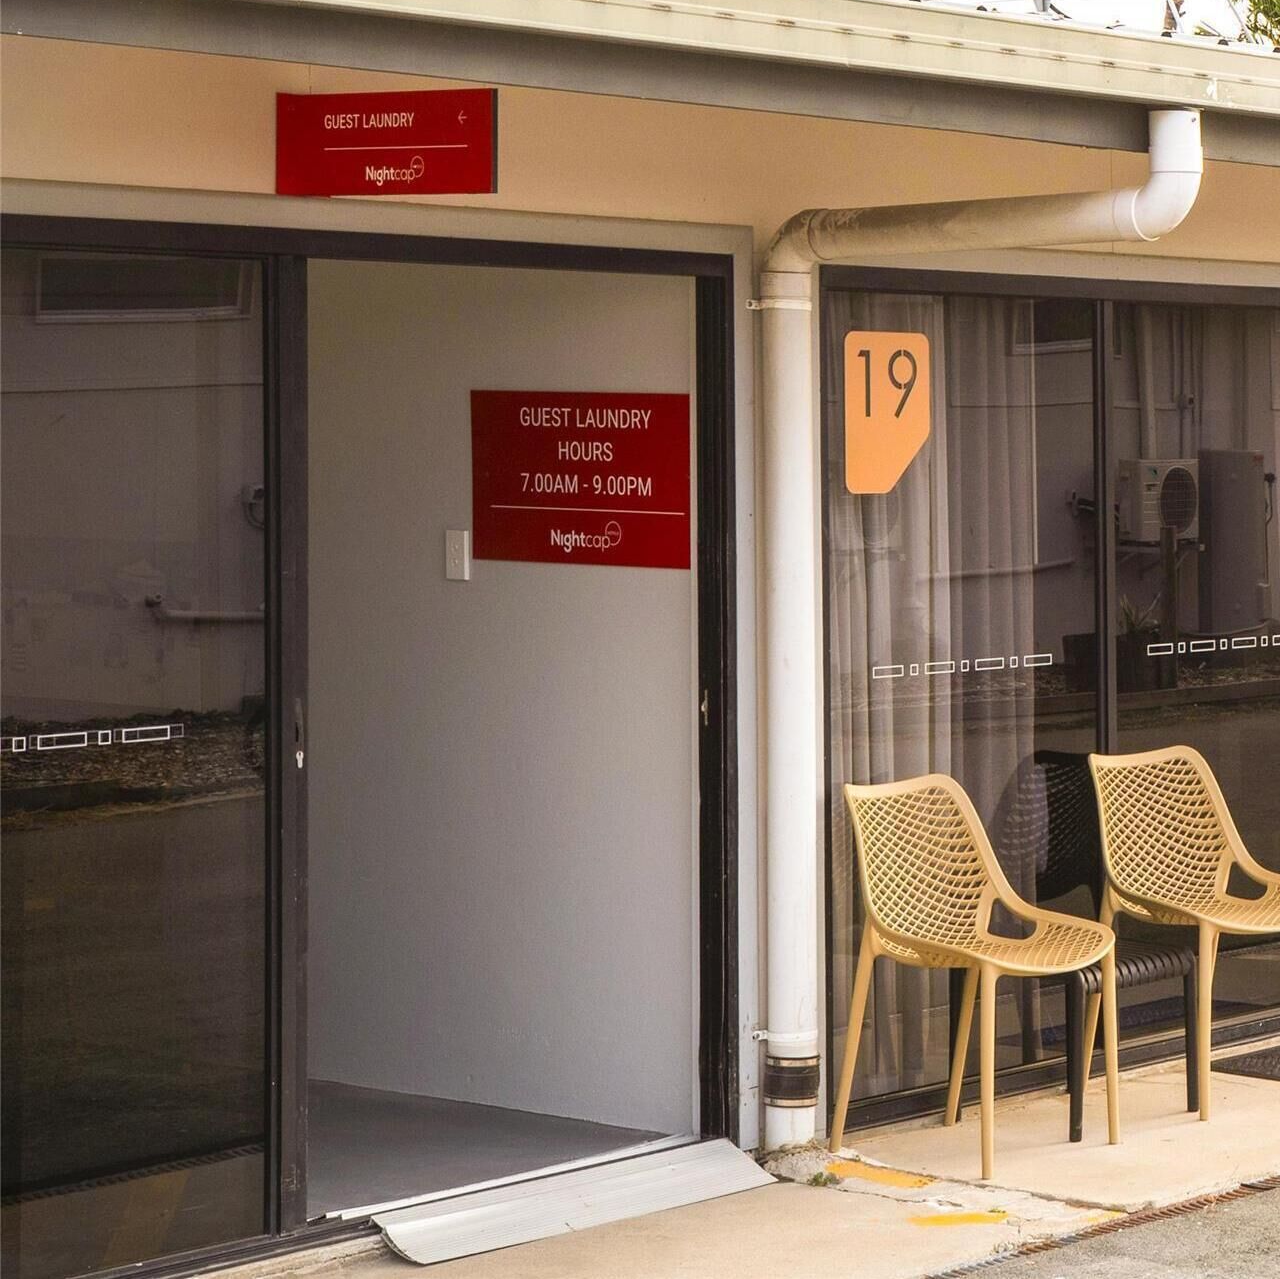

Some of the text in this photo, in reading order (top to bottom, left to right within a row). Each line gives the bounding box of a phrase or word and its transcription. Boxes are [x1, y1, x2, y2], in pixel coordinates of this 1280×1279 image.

[324, 112, 415, 129] GUEST LAUNDRY
[365, 166, 415, 186] Nightcap
[857, 349, 918, 419] 19
[519, 407, 652, 430] GUEST LAUNDRY
[558, 441, 614, 462] HOURS
[520, 472, 579, 494] 7.00AM
[592, 476, 653, 497] 9.00PM
[550, 528, 611, 553] Nightcap
